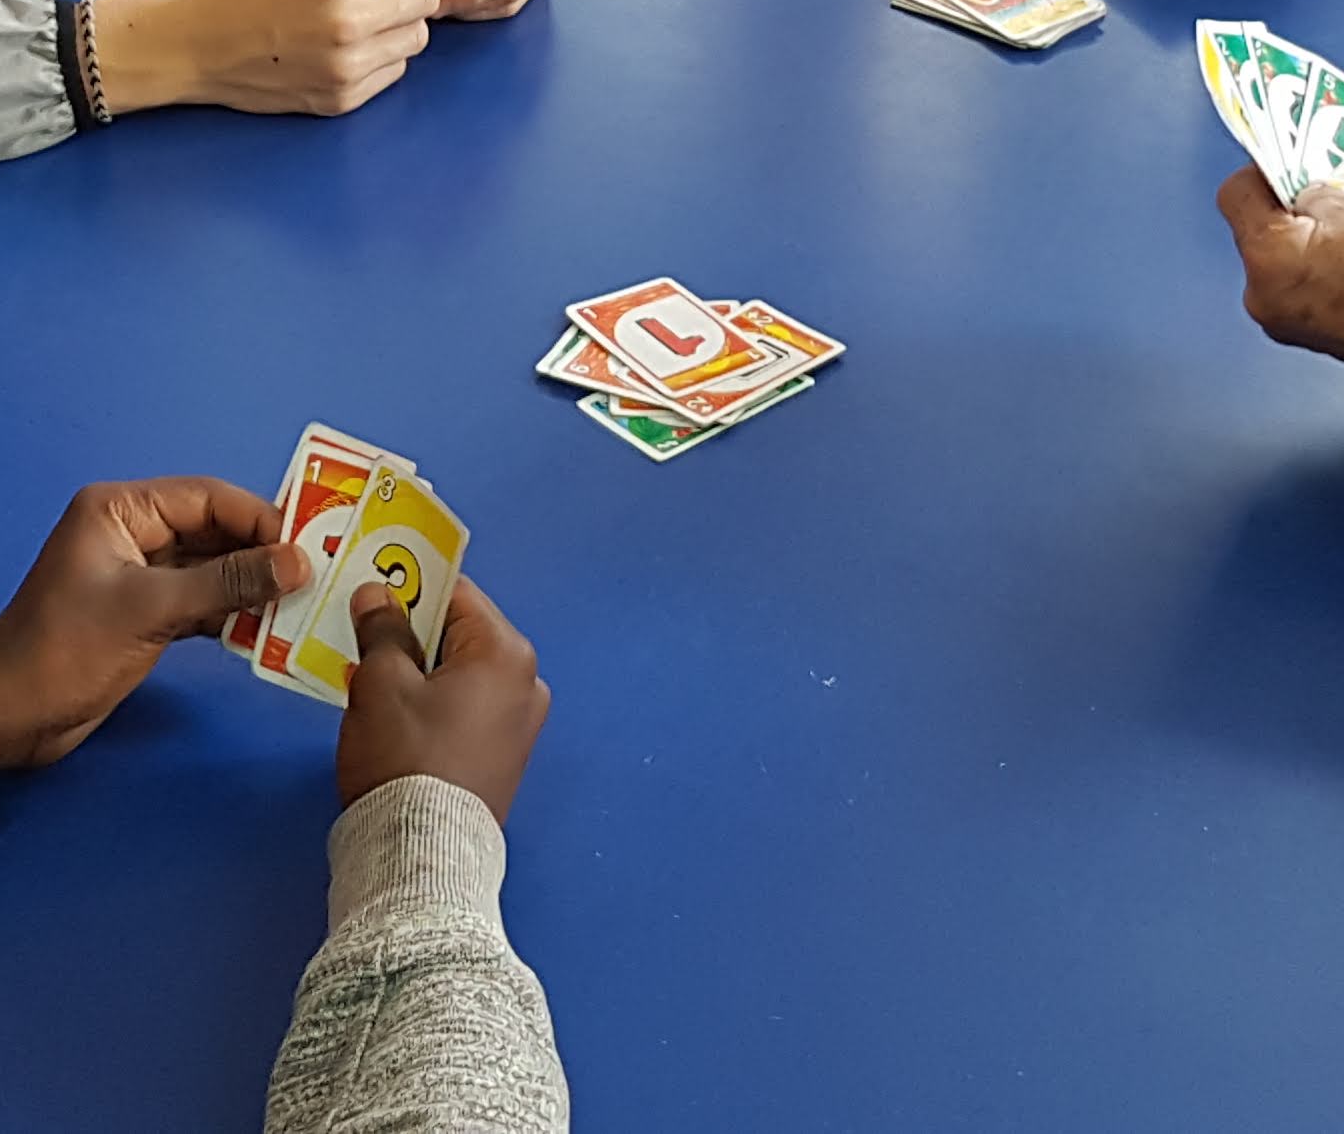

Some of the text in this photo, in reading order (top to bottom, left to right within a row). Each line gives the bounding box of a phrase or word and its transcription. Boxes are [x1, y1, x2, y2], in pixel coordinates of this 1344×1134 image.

[635, 317, 706, 357] 1
[309, 459, 322, 485] 1
[376, 473, 397, 502] 3
